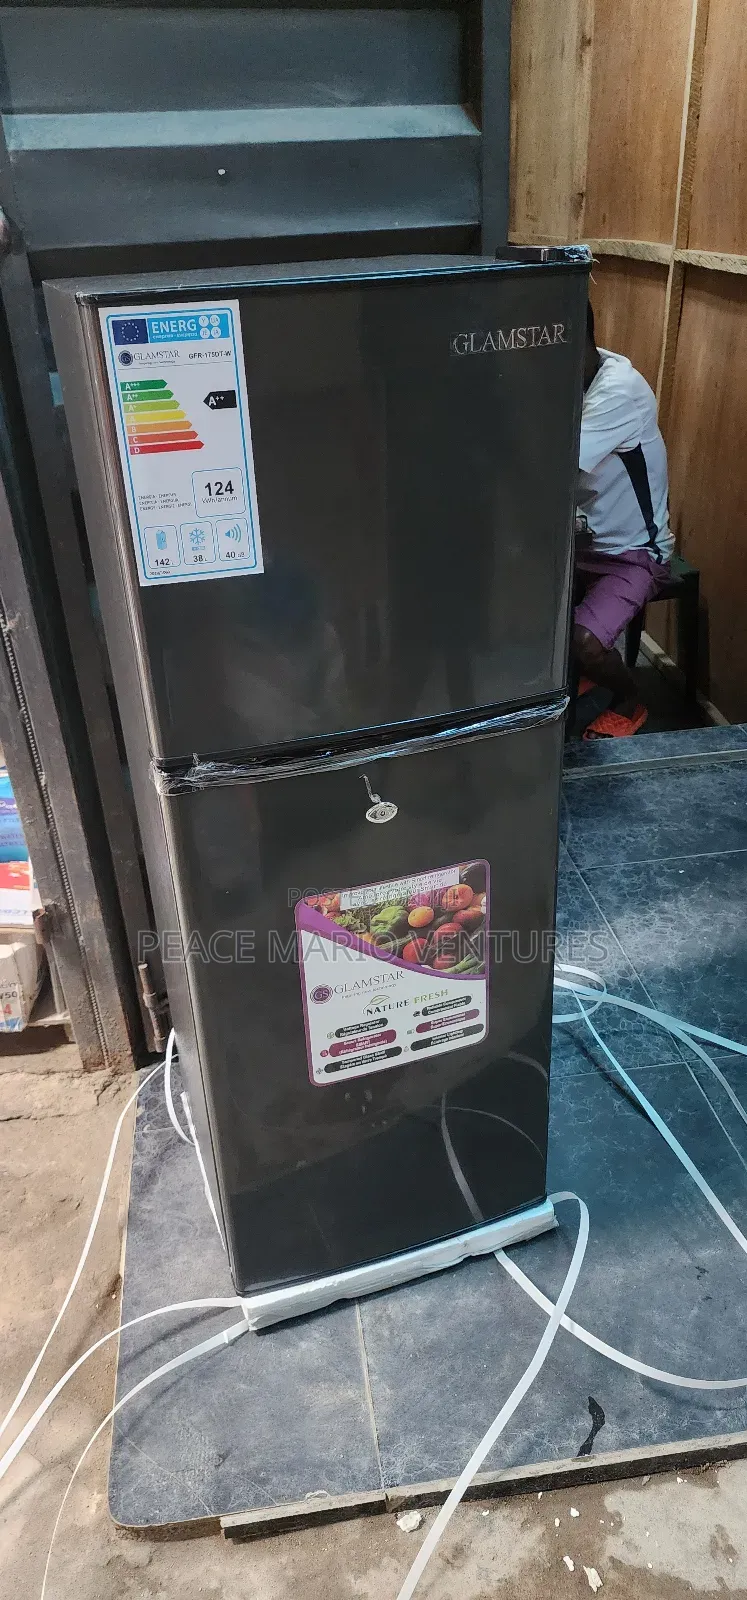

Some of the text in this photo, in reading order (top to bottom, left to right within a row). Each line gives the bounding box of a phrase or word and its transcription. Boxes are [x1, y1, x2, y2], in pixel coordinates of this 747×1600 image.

[152, 320, 196, 334] ENERG
[453, 324, 567, 354] GLAMSTAR
[134, 350, 180, 360] GLAMSTAR
[209, 396, 224, 406] A++
[204, 480, 234, 497] 124
[334, 971, 404, 994] GLAMSTAR
[314, 990, 328, 999] GS
[367, 989, 449, 1016] NATURE FRESH
